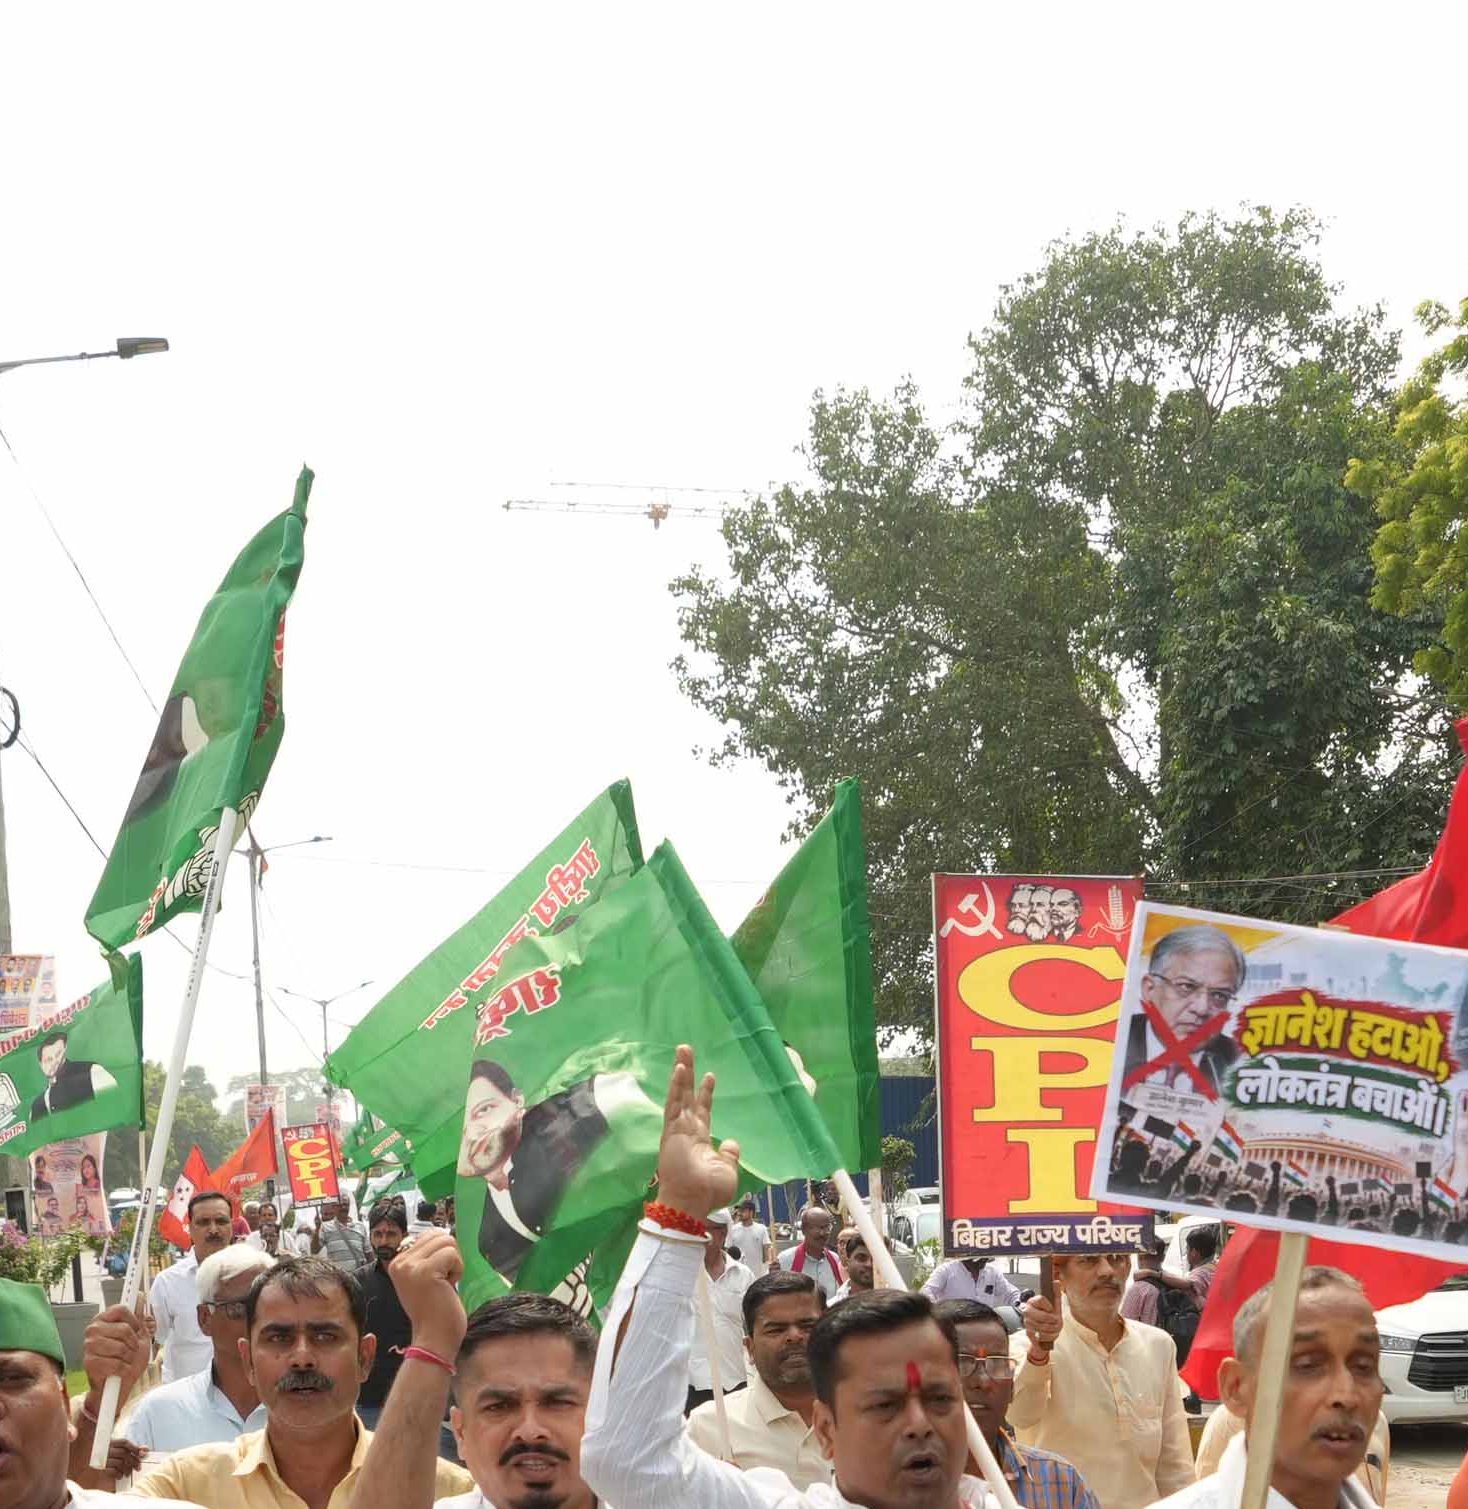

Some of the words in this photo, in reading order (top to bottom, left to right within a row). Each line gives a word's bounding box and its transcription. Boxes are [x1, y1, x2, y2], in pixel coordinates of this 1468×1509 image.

[1241, 989, 1348, 1057] ज्ञानेश
[1347, 1009, 1451, 1082] हटाओ,
[1235, 1055, 1353, 1111] लोकतंत्र
[289, 1138, 332, 1200] CPI
[951, 1218, 1014, 1249] बिहार
[1016, 1223, 1071, 1246] राज्य
[1074, 1215, 1145, 1250] परिषद्
